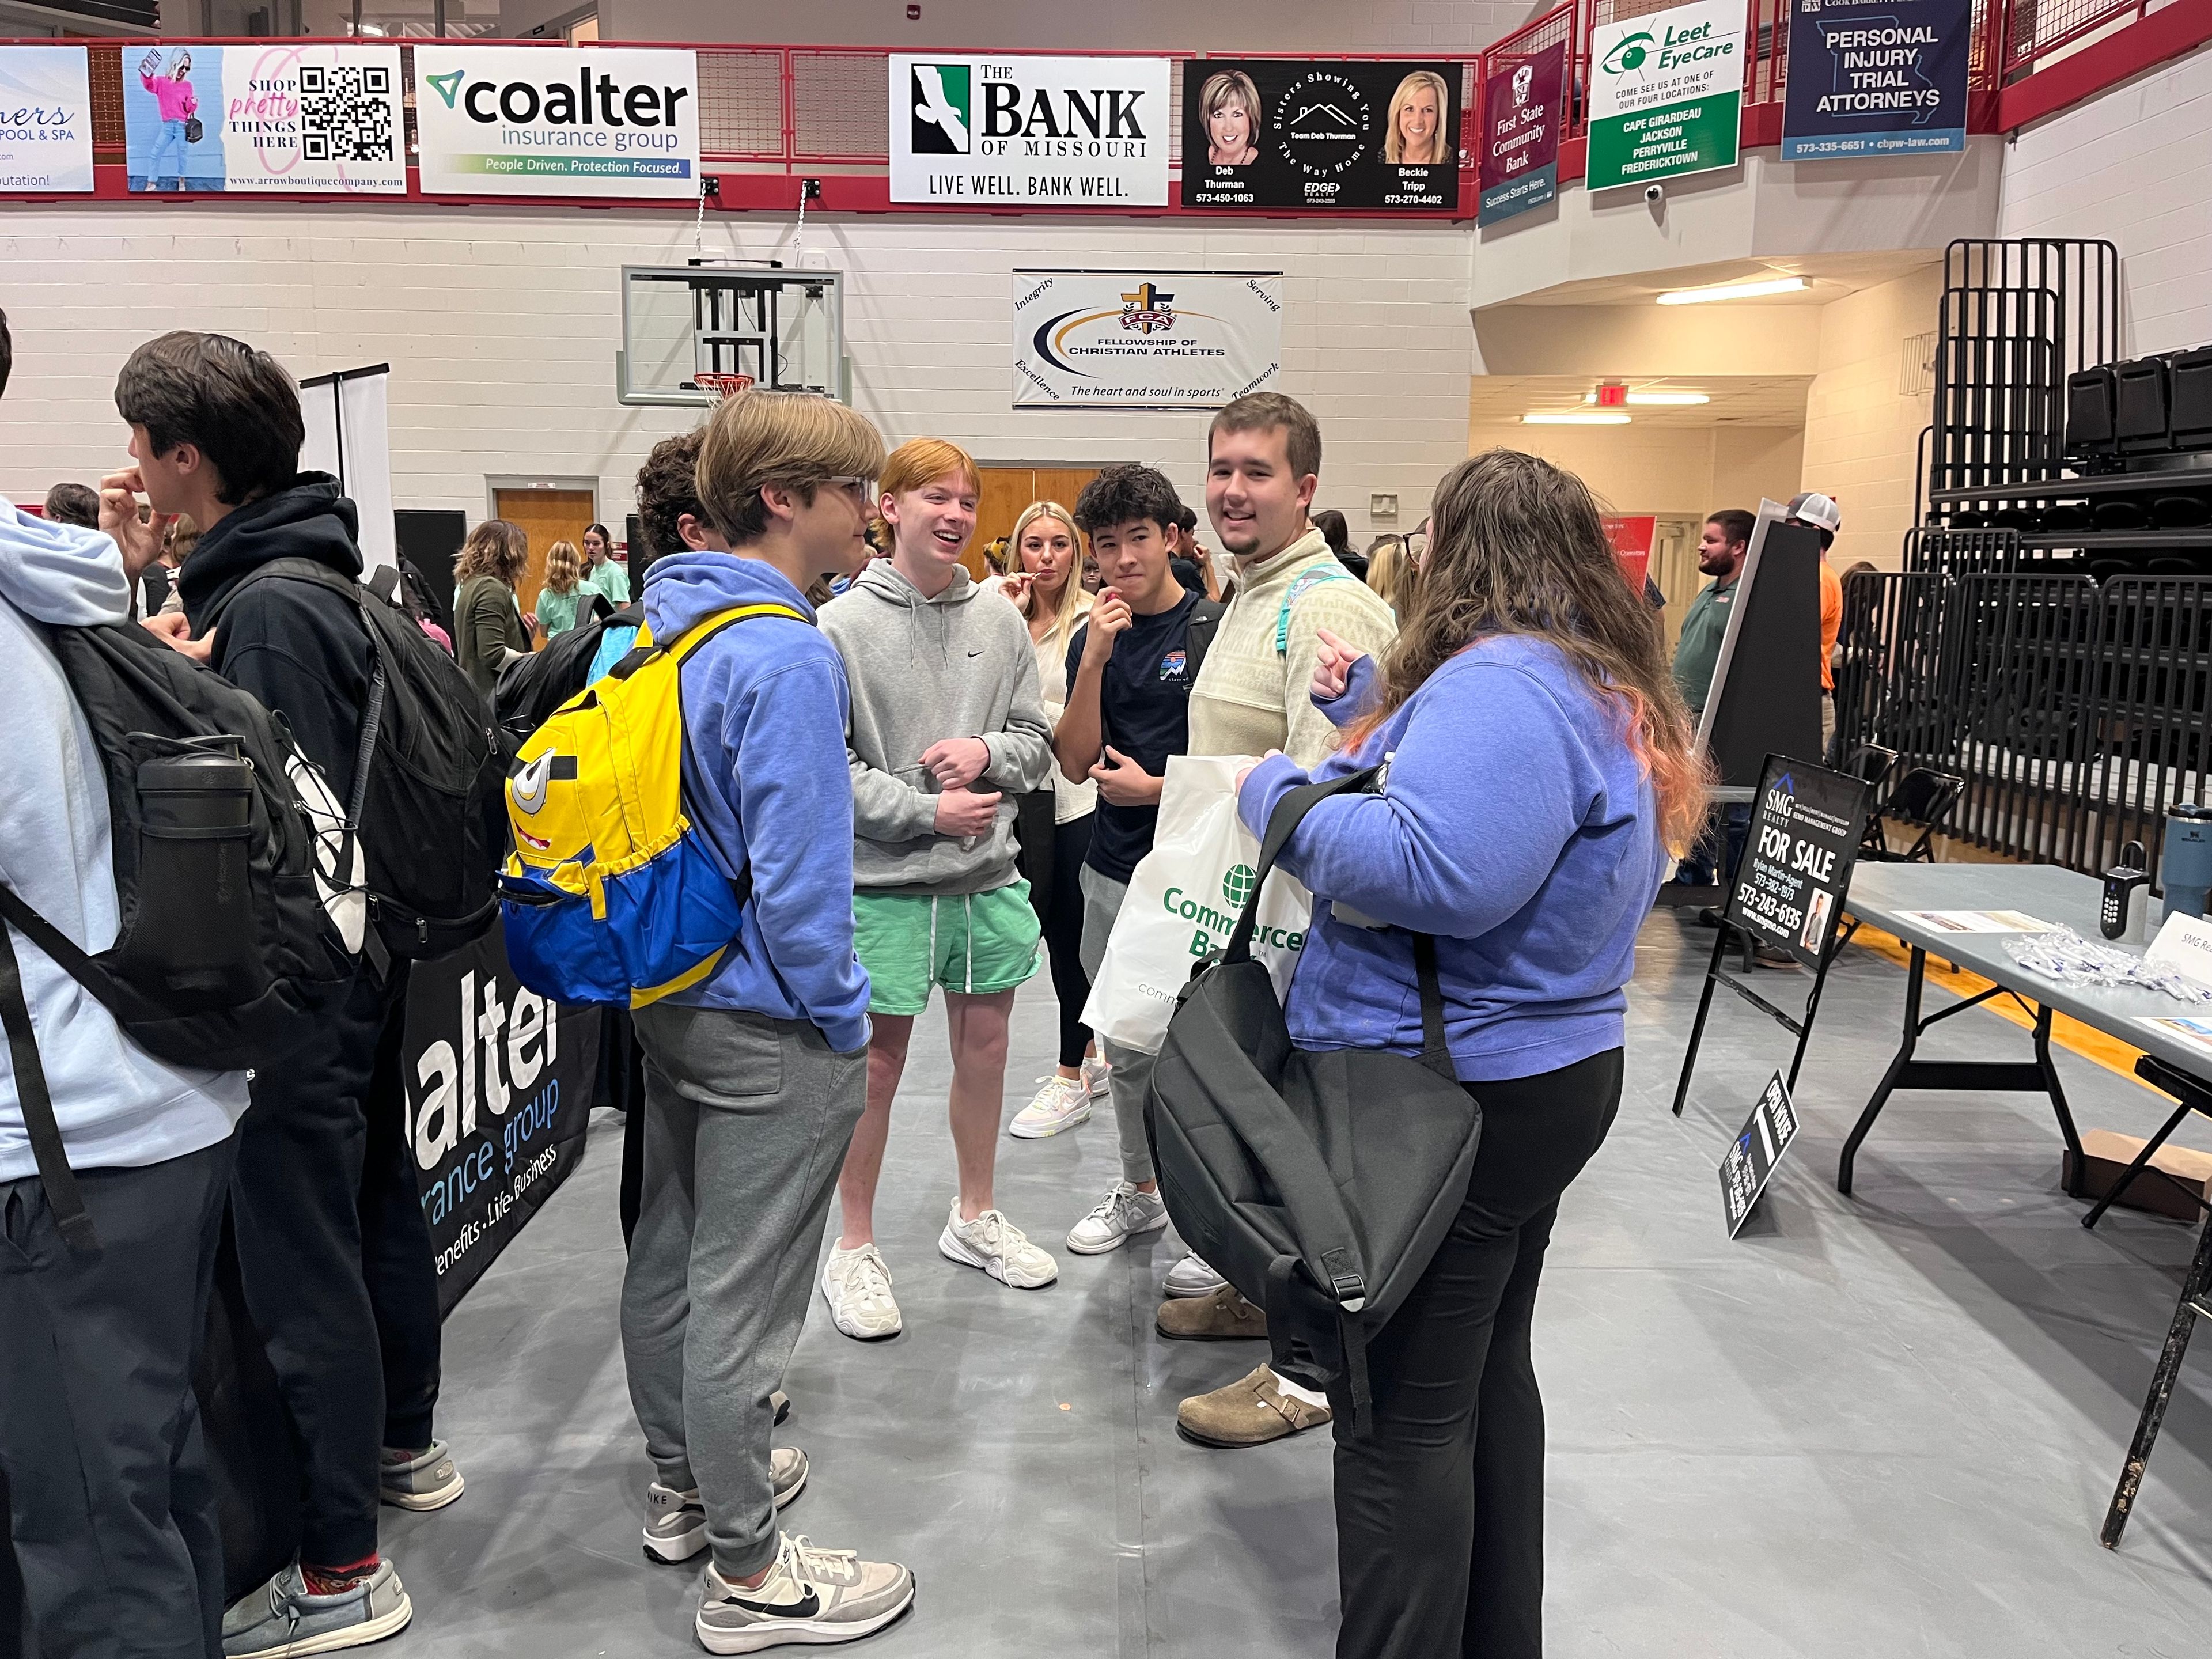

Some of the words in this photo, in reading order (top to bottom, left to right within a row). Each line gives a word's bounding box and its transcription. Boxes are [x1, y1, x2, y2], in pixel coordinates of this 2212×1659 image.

[1664, 21, 1711, 47] Leet
[1827, 26, 1938, 48] PERSONAL
[1658, 40, 1733, 70] EyeCare
[1844, 48, 1918, 69] INJURY
[980, 65, 1013, 79] THE
[1850, 70, 1909, 89] TRIAL
[249, 79, 296, 91] SHOP
[1616, 87, 1638, 99] COME
[1642, 83, 1655, 93] SEE
[1658, 80, 1668, 89] US
[1671, 77, 1681, 86] AT
[1684, 73, 1700, 84] ONE
[1703, 70, 1714, 80] OF
[1619, 99, 1635, 109] OUR
[1638, 94, 1658, 105] FOUR
[1661, 83, 1710, 100] LOCATIONS:
[230, 92, 298, 120] pretty
[464, 67, 688, 127] coalter
[1274, 82, 1301, 130] Sisters
[1308, 72, 1360, 100] Showing
[1360, 103, 1369, 130] You
[1816, 89, 1940, 112] ATTORNEYS
[981, 82, 1146, 139] BANK
[1497, 115, 1516, 136] First
[1521, 104, 1544, 124] State
[1623, 118, 1647, 133] CAPE
[1649, 107, 1702, 127] GIRARDEAU
[39, 130, 48, 141] &
[52, 130, 75, 141] SPA
[229, 121, 296, 132] THINGS
[502, 124, 607, 146] insurance
[615, 132, 678, 151] group
[1639, 126, 1683, 143] JACKSON
[253, 137, 297, 147] HERE
[981, 140, 1007, 156] OF
[1024, 141, 1146, 158] MISSOURI
[1493, 124, 1545, 157] Community
[1633, 139, 1687, 159] PERRYVILLE
[1797, 140, 1865, 153] 573-335-6651
[1877, 137, 1949, 150] cbpw-law.com
[486, 158, 522, 171] People
[527, 159, 567, 171] Driven.
[571, 160, 630, 173] Protection
[633, 162, 682, 174] Focused.
[1215, 166, 1234, 175] Deb
[1279, 142, 1296, 165] The
[1303, 164, 1327, 177] Way
[1335, 144, 1365, 172] Home
[1506, 150, 1529, 173] Bank
[1622, 151, 1698, 175] FREDERICKTOWN
[0, 175, 50, 186] utation!
[230, 176, 403, 187] www.arrowboutiquecompany.com
[1398, 167, 1429, 176] Beckie
[930, 175, 964, 195] LIVE
[971, 175, 1020, 195] WELL.
[1028, 176, 1072, 196] BANK
[1080, 177, 1128, 197] WELL.
[1205, 180, 1244, 189] Thurman
[1304, 183, 1335, 192] EDGE
[1402, 181, 1425, 192] Tripp
[1486, 191, 1509, 208] Success
[1510, 183, 1528, 199] Starts
[1196, 194, 1254, 202] 573-450-1063
[1385, 195, 1442, 204] 573-270-4402
[1014, 278, 1054, 311] Integrity
[1247, 279, 1281, 312] Serving
[1124, 313, 1171, 325] FCA
[1069, 347, 1147, 355] CHRISTIAN
[1153, 348, 1225, 356] ATHLETES
[1014, 359, 1060, 401] Excellence
[1232, 362, 1279, 400] Teamwork
[1072, 386, 1091, 396] The
[1093, 386, 1123, 396] heart
[1125, 387, 1146, 396] and
[1149, 387, 1172, 397] soul
[1174, 387, 1184, 396] in
[1187, 388, 1221, 399] sports
[1766, 789, 1794, 817] SMG
[1763, 810, 1790, 828] REALTY
[1758, 825, 1790, 863] FOR
[1791, 839, 1836, 883] SALE
[1754, 872, 1795, 901] 573-382-1973
[1738, 882, 1802, 930] 573-243-6135
[1742, 906, 1790, 938] www.smgmo.com
[2181, 933, 2202, 946] SMG
[1766, 1079, 1783, 1114] OPEN
[504, 1078, 558, 1175] group
[1774, 1101, 1792, 1146] HOUSE
[435, 1221, 480, 1275] enefits
[488, 1191, 511, 1226] Life
[514, 1144, 556, 1200] Business
